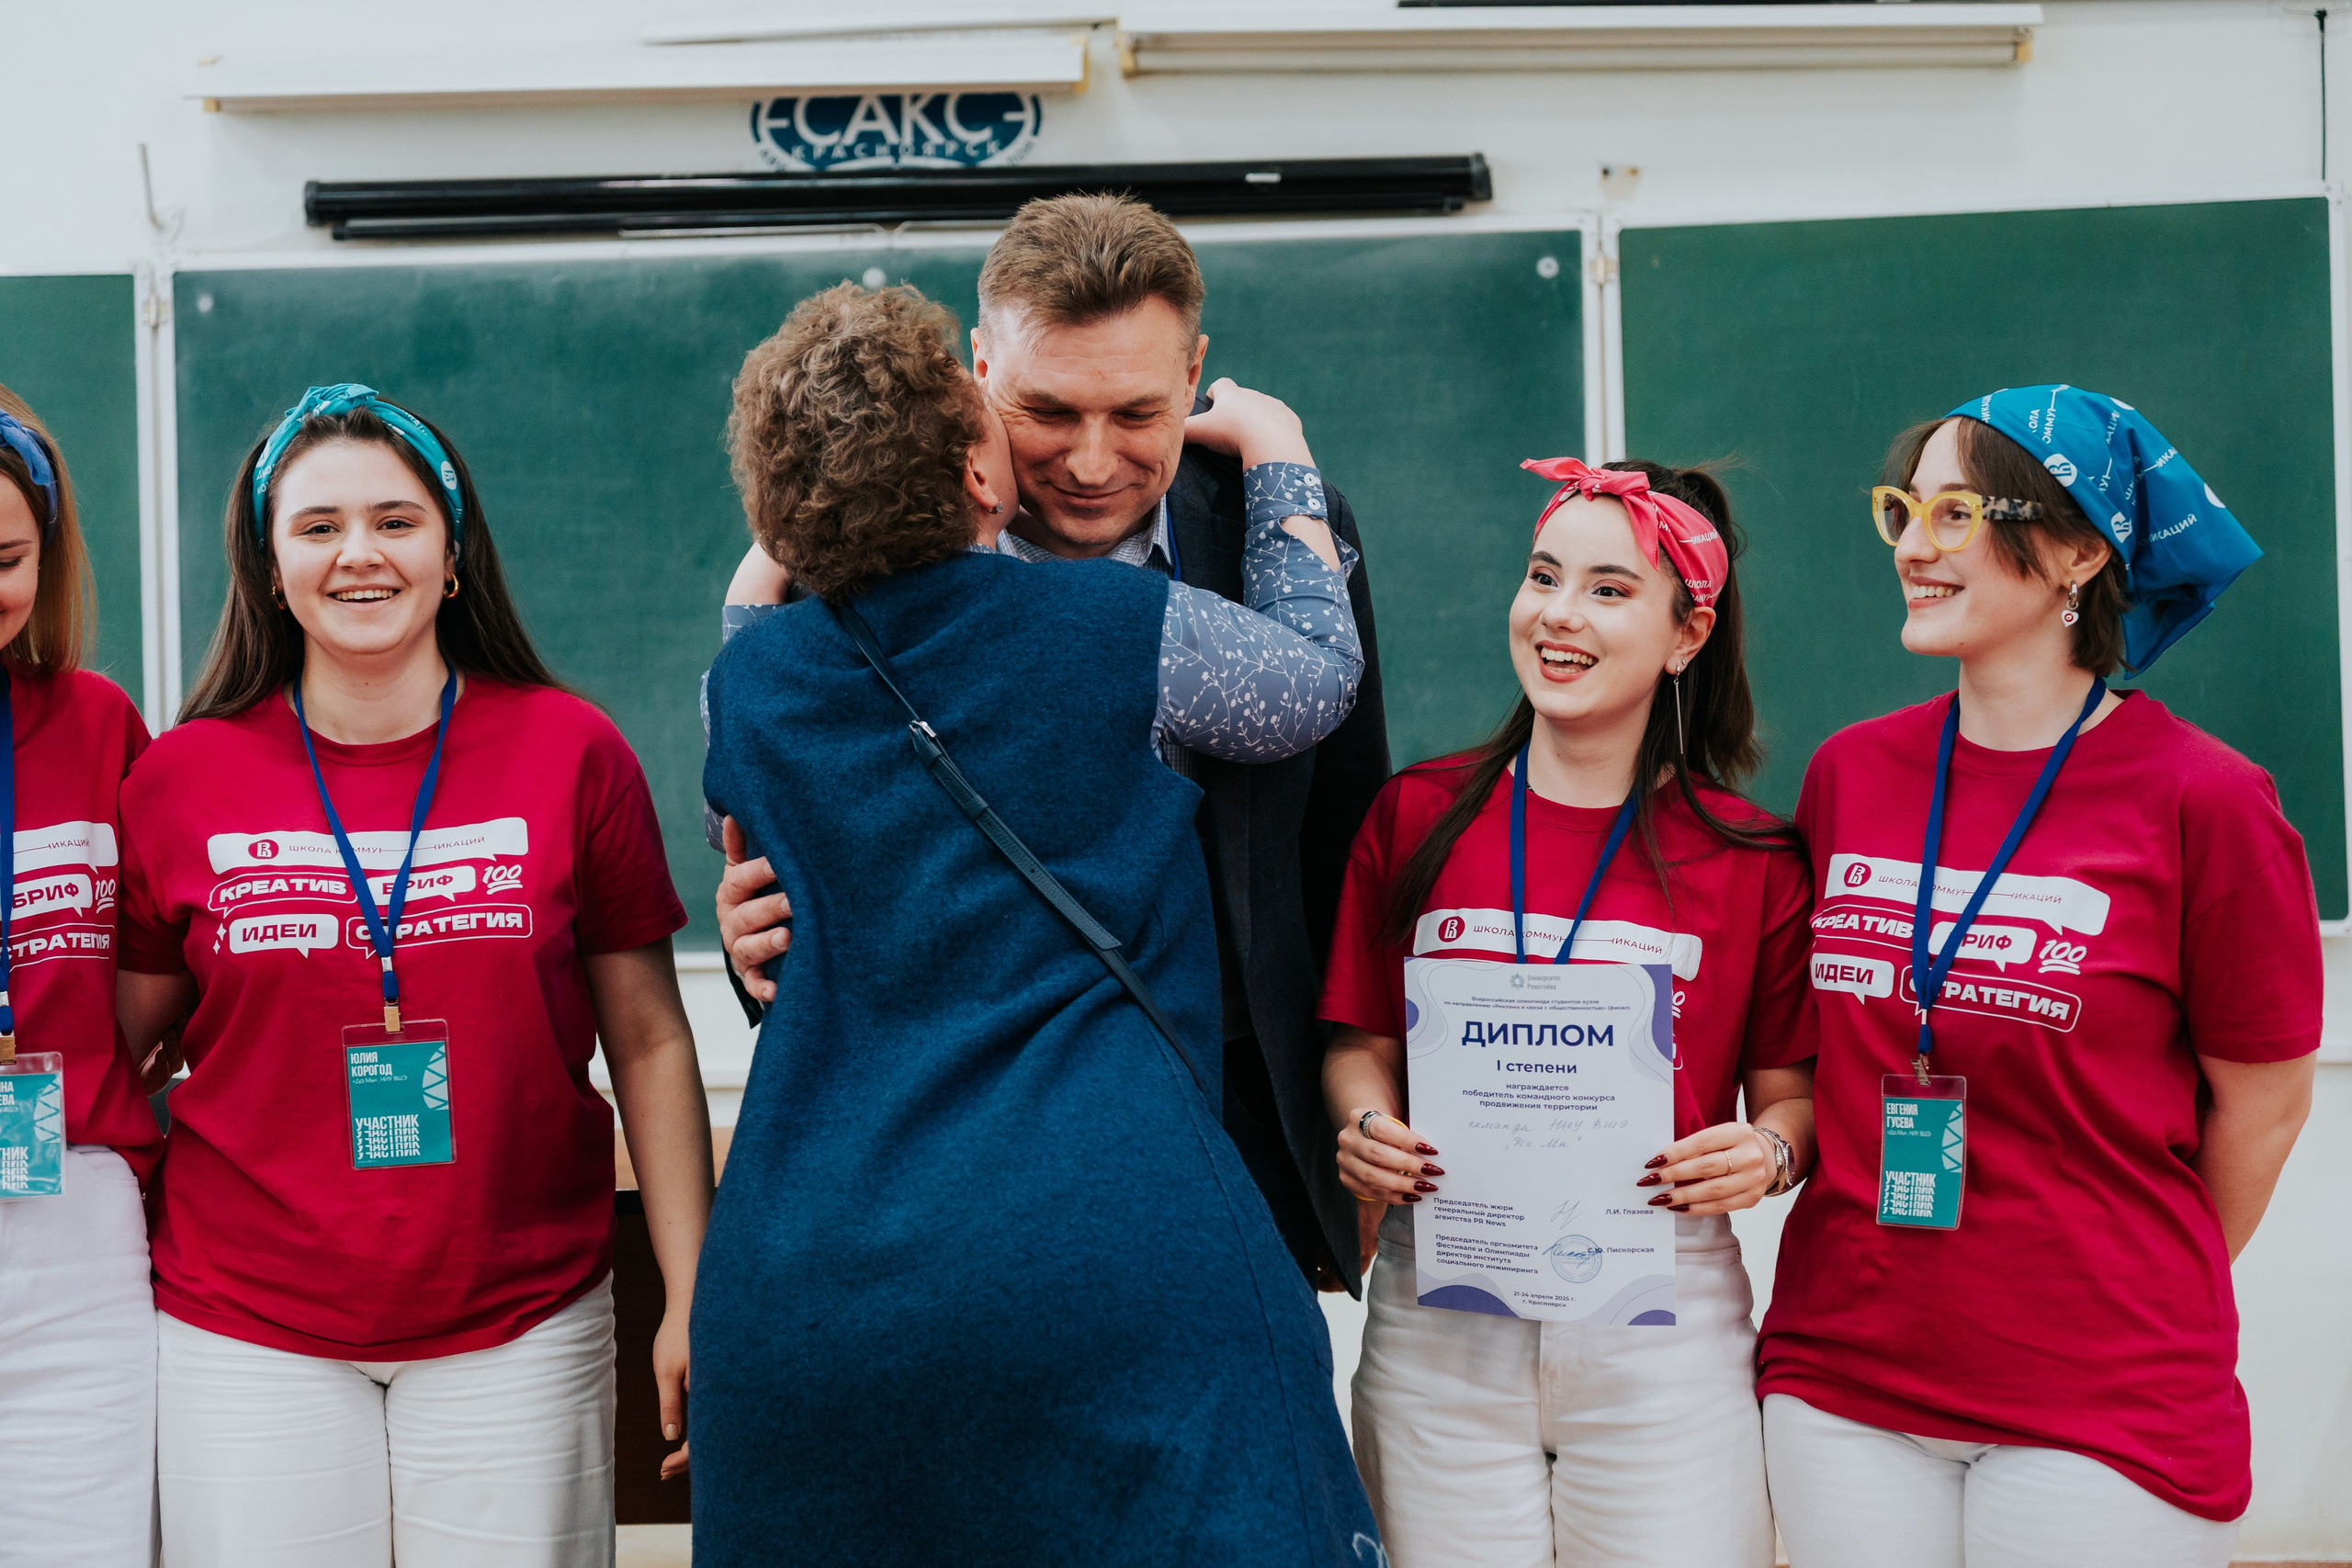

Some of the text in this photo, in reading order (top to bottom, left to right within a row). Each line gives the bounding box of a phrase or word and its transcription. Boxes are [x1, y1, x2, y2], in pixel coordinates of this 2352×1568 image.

[790, 139, 1001, 160] КРАСНОЯРСК
[288, 845, 332, 854] ШКОЛА
[482, 864, 523, 885] 100
[1878, 875, 1918, 888] ШКОЛА
[14, 883, 79, 909] БРИФ
[96, 879, 116, 901] 100
[220, 878, 347, 904] КРЕАТИВ
[242, 923, 317, 943] ИДЕИ
[356, 912, 523, 941] СРАТЕГИЯ
[1473, 925, 1515, 938] ШКОЛА
[1812, 913, 1915, 939] КРЕАТИВ
[1961, 933, 2012, 951] РИФ
[2039, 939, 2087, 963] 100
[1527, 975, 1561, 983] Университет
[1815, 963, 1874, 986] ИДЕИ
[1462, 1021, 1614, 1048] ДИПЛОМ
[350, 1052, 378, 1064] ЮЛИЯ
[351, 1064, 392, 1077] КОРОГОД
[1506, 1061, 1577, 1074] степени
[1463, 1089, 1514, 1100] победитель
[1516, 1093, 1571, 1101] командного
[1506, 1083, 1569, 1092] награждается
[1479, 1100, 1599, 1111] продвижения территории
[1886, 1102, 1918, 1115] ЕВГЕНИЯ
[355, 1113, 420, 1132] УЧАСТНИК
[1468, 1120, 1535, 1135] команда
[1886, 1116, 1914, 1128] ГУСЕВА
[1885, 1170, 1937, 1188] УЧАСТНИК
[1433, 1197, 1513, 1212] Председатель жюри
[1434, 1205, 1525, 1222] генеральный директор
[1434, 1213, 1472, 1224] агентства
[1485, 1219, 1507, 1227] News
[1435, 1234, 1539, 1251] Председатель оргкомитета
[1435, 1242, 1476, 1252] Фестиваля
[1484, 1247, 1530, 1258] Олимпиады
[1436, 1250, 1511, 1264] директор института
[1437, 1258, 1539, 1275] социального инжиниринга
[1528, 1299, 1567, 1308] Красноярск
